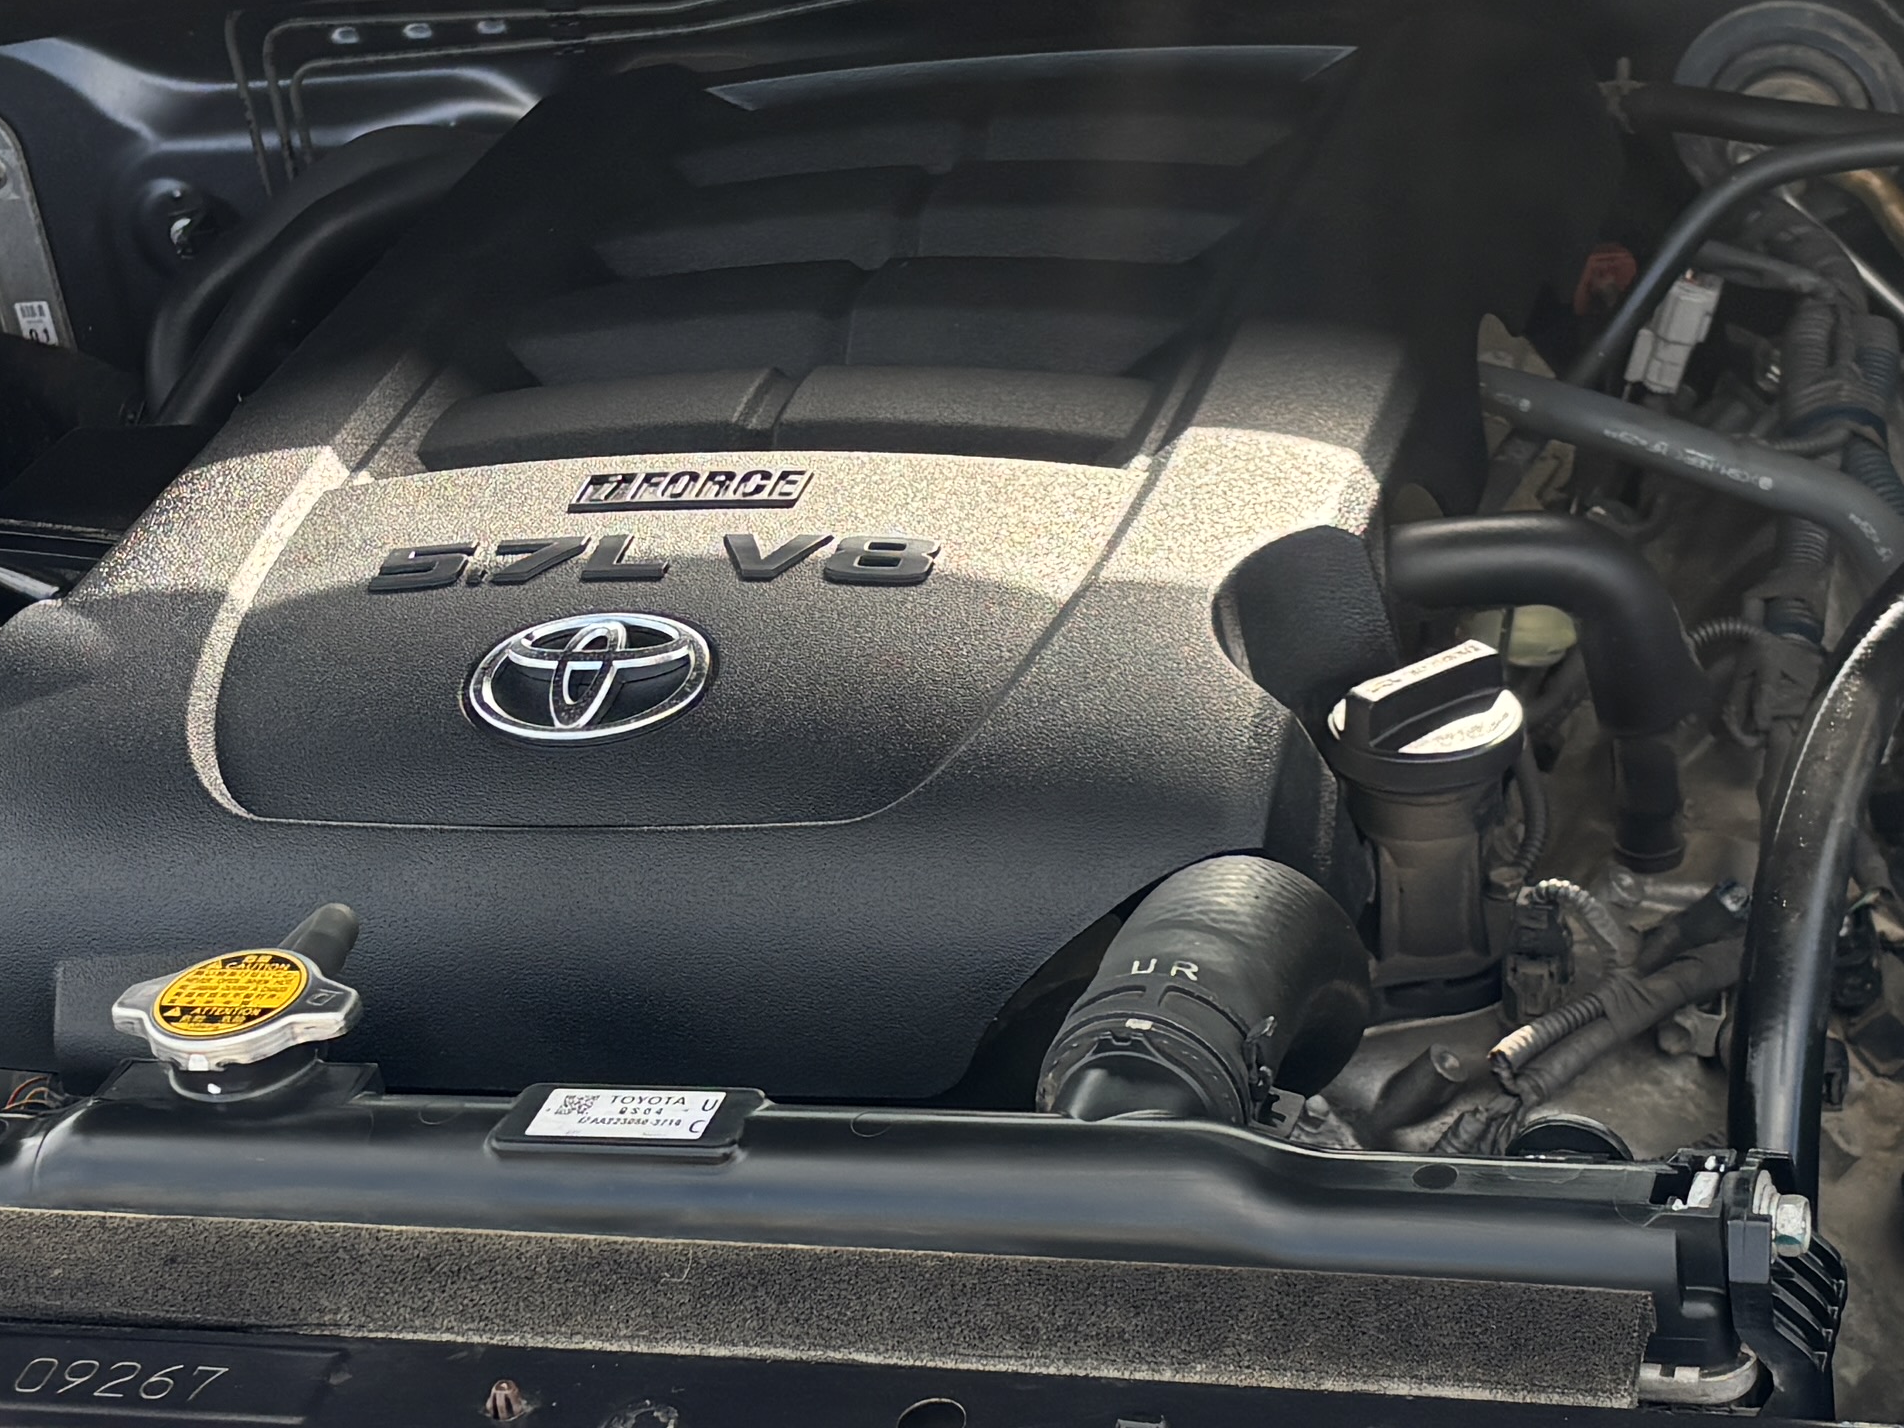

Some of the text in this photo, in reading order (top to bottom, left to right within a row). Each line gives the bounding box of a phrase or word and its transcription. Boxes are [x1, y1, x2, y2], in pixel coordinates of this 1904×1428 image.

[367, 533, 943, 592] 5.7L V8
[225, 961, 291, 971] CAUTION
[610, 1094, 686, 1106] TOYOTA
[701, 1097, 720, 1113] U
[688, 1119, 707, 1134] C
[13, 1356, 230, 1402] 09267
